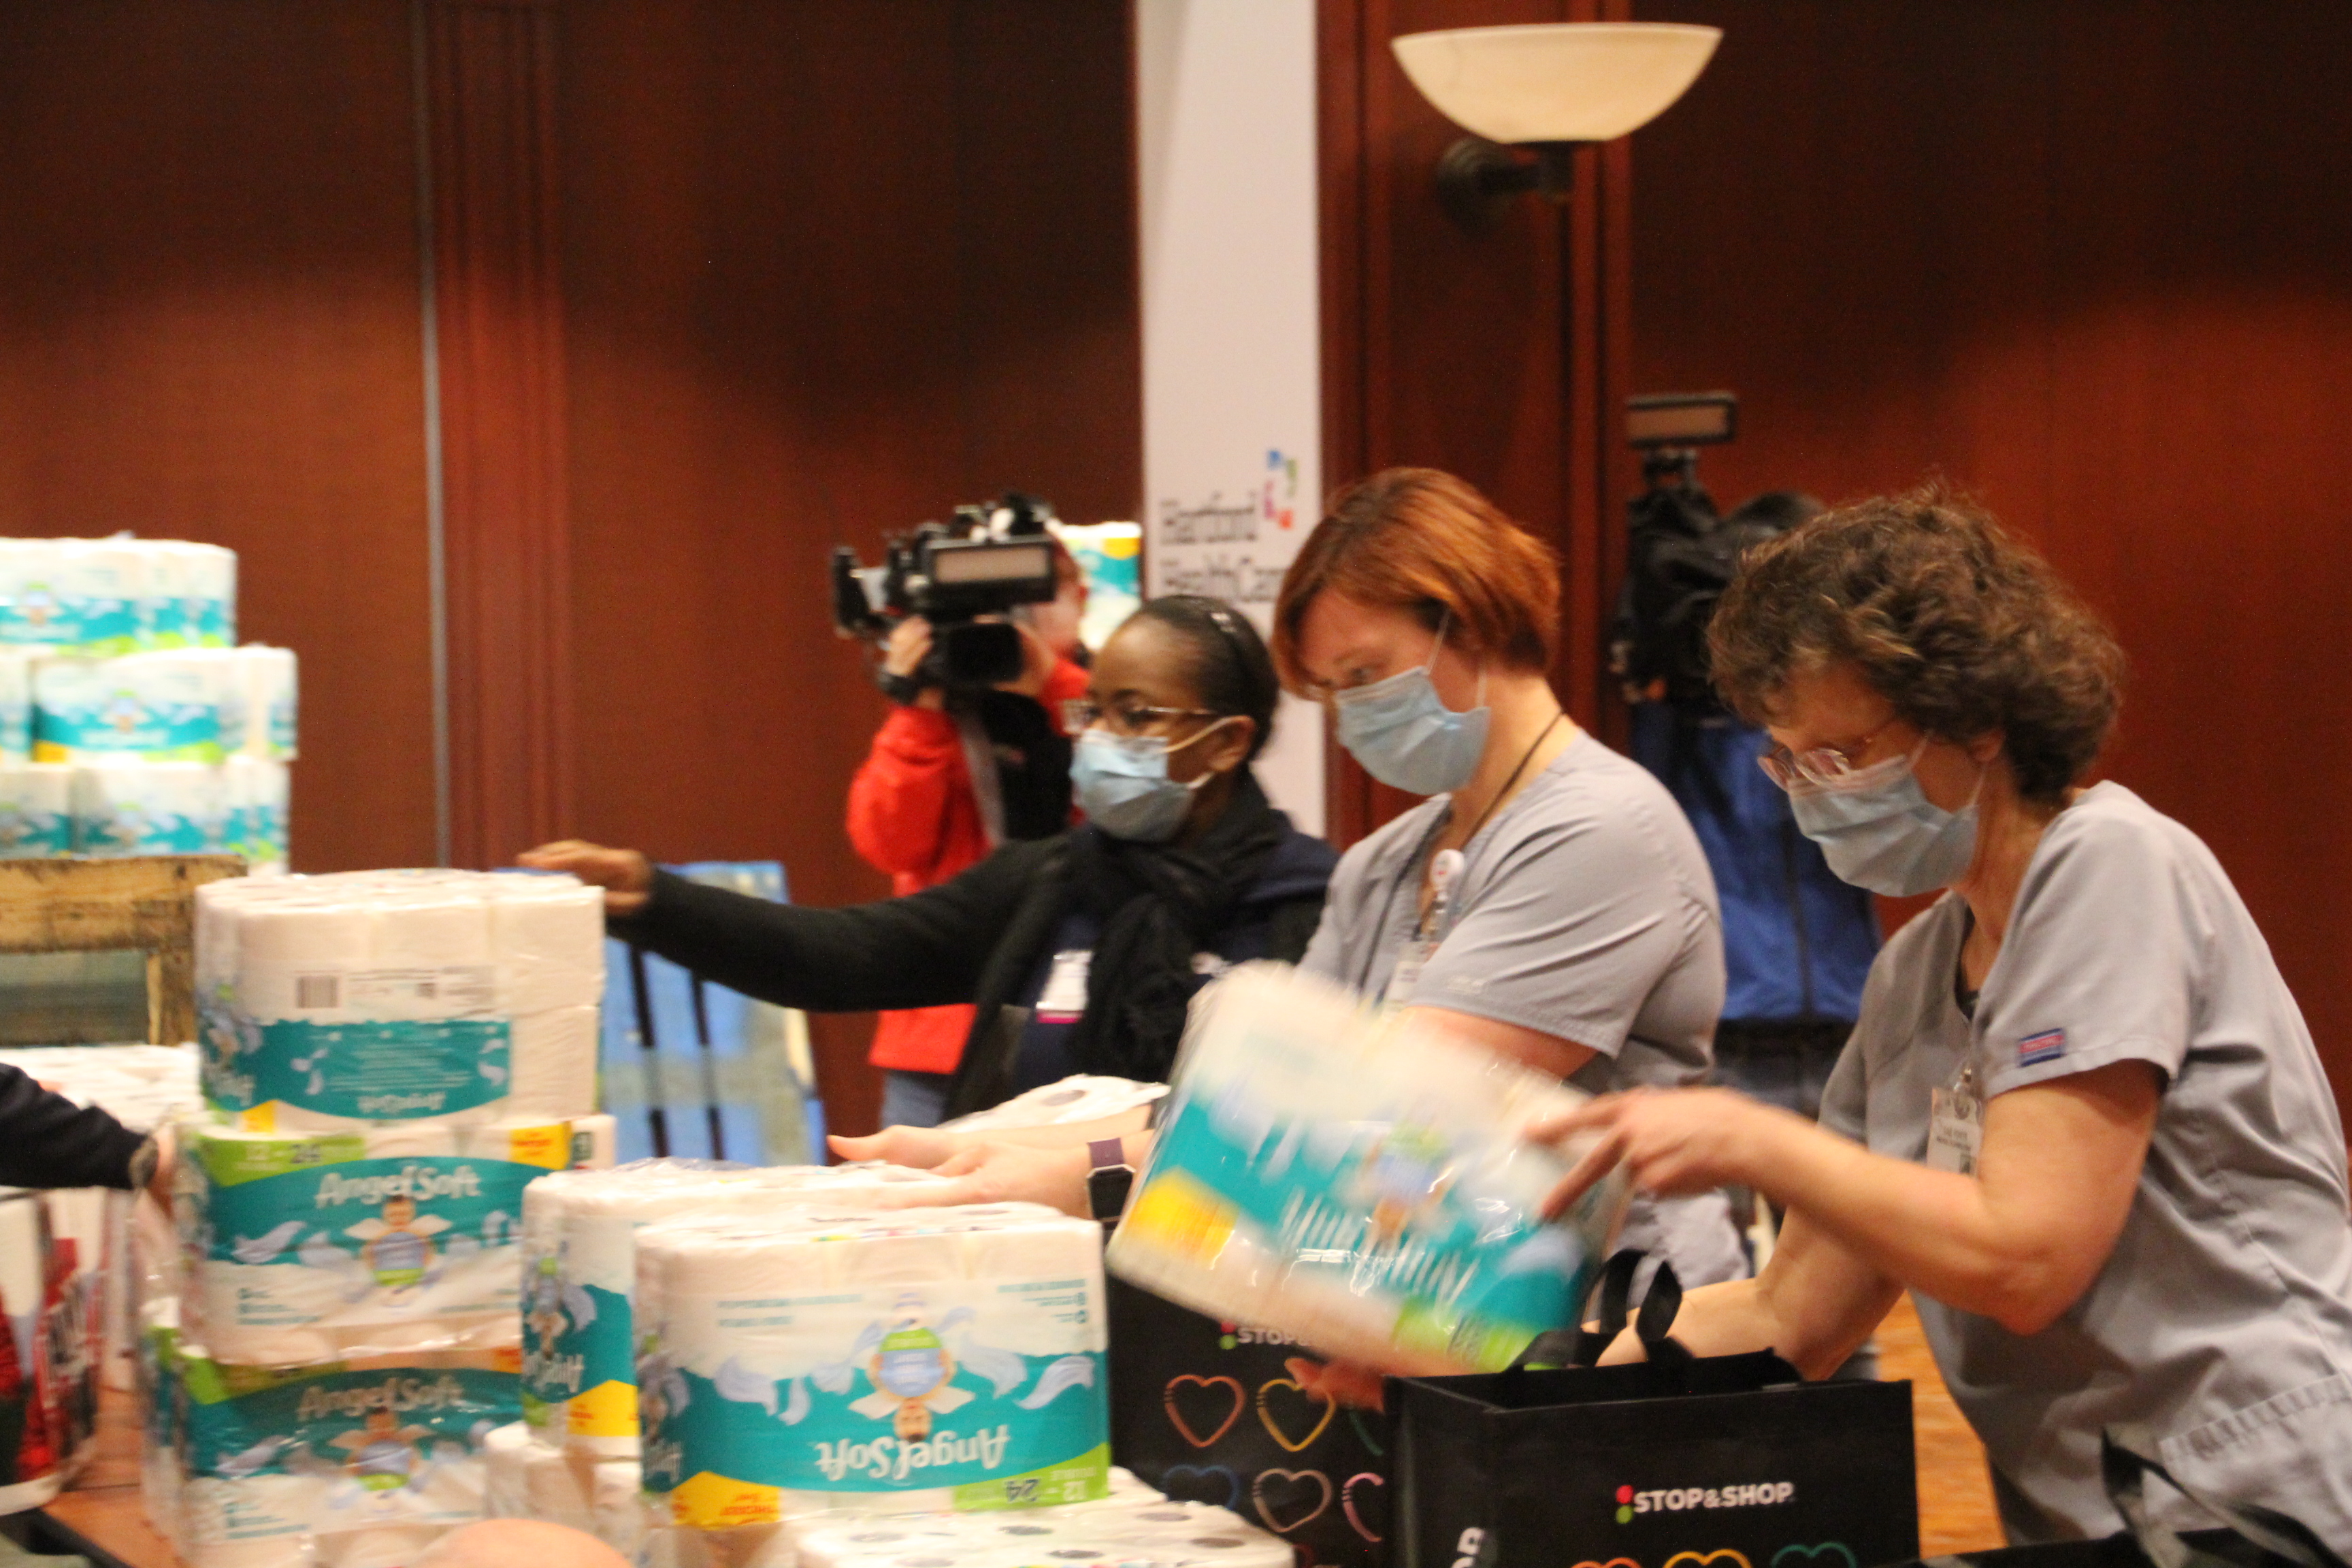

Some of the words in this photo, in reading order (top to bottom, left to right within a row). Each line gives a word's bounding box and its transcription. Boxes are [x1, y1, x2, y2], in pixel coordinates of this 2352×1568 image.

[314, 1165, 417, 1209] Angel
[412, 1164, 481, 1201] Soft
[815, 1436, 897, 1482] Soft
[892, 1424, 1011, 1481] Angel
[1004, 1477, 1041, 1503] 24
[1633, 1481, 1795, 1514] STOP&SHOP
